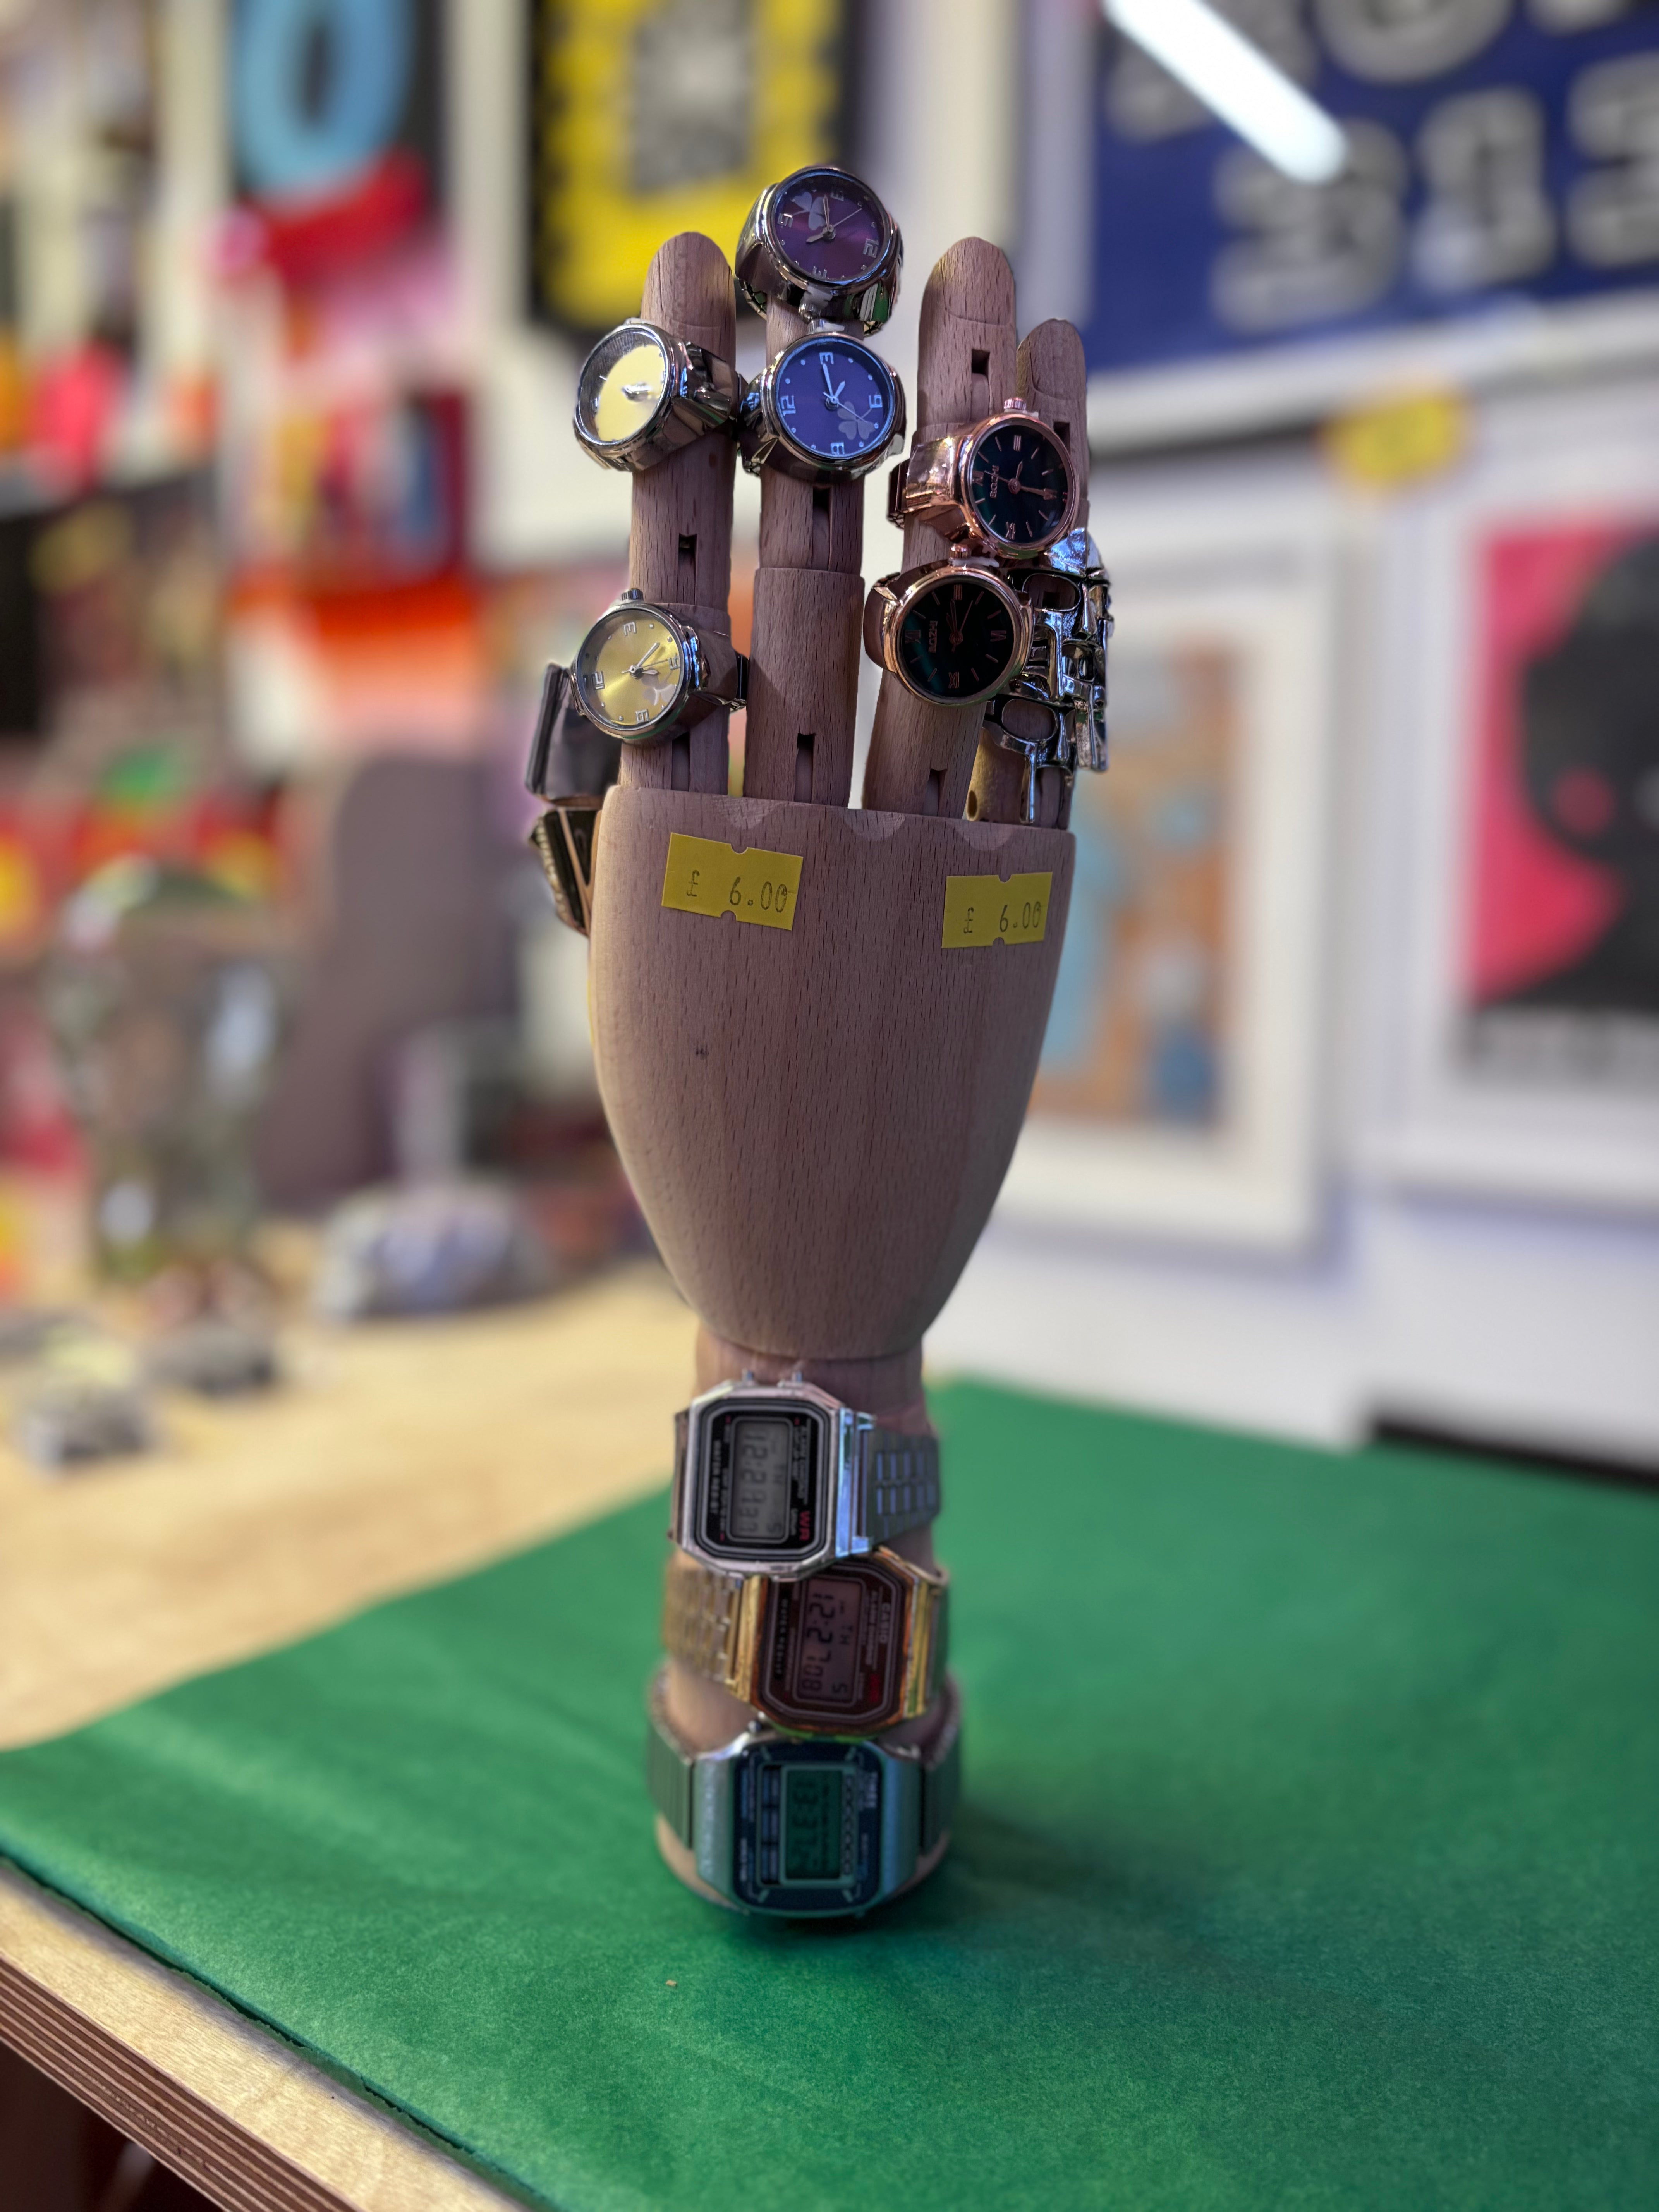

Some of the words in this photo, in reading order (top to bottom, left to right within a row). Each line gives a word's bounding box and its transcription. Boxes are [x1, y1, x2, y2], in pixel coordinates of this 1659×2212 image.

[780, 395, 796, 416] 12
[686, 870, 700, 897] £
[729, 876, 787, 913] 6.00
[963, 907, 974, 933] £
[1000, 901, 1041, 932] 6.00
